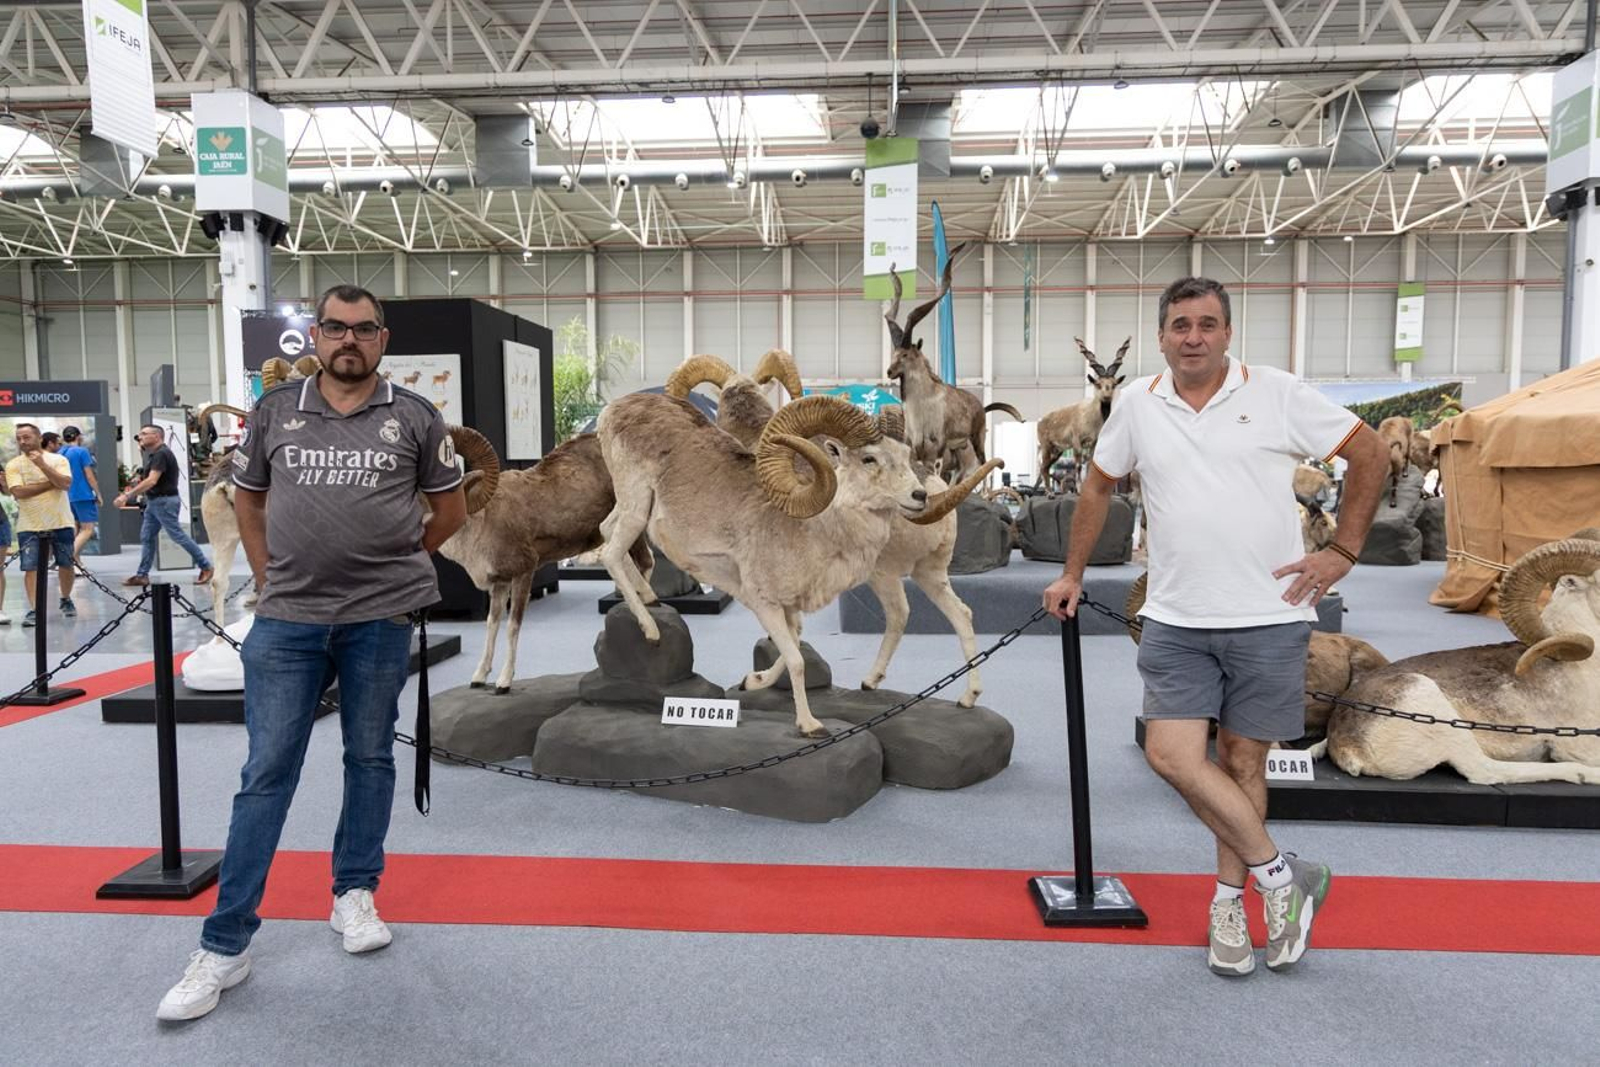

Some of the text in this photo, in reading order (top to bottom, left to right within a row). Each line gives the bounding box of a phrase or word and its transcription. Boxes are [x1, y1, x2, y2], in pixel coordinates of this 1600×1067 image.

[109, 23, 141, 51] IFEJA
[219, 152, 245, 160] RURAL
[16, 393, 70, 403] HIKMICRO
[284, 445, 398, 471] Emirates
[297, 469, 380, 488] FLY BETTER
[667, 706, 733, 720] NO TOCAR
[1268, 760, 1308, 773] OCAR
